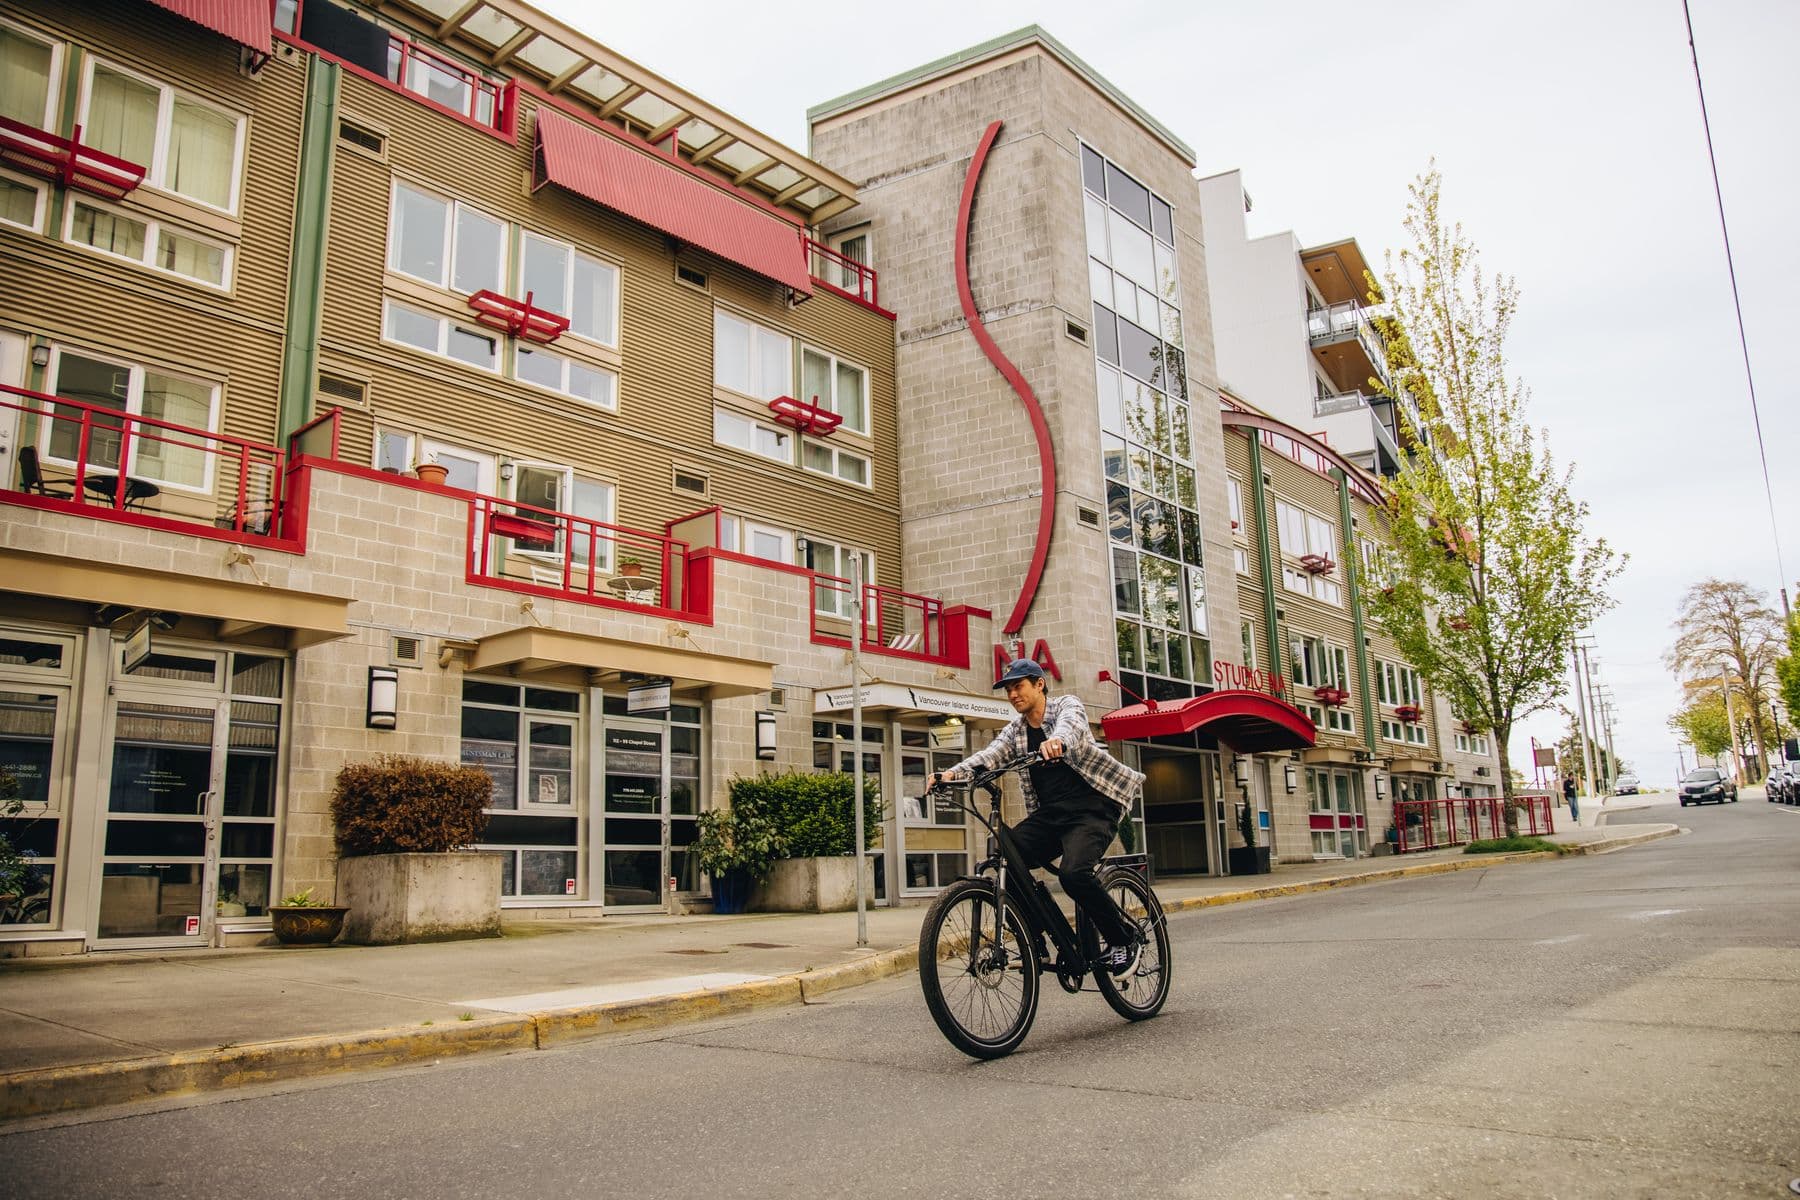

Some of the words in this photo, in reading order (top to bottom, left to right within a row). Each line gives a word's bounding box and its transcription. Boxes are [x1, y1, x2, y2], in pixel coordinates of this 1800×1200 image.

[993, 638, 1063, 682] NA
[1214, 661, 1263, 690] STUDIO
[1267, 672, 1287, 695] NA
[918, 695, 951, 707] Vancouver
[951, 700, 970, 710] Island
[970, 703, 999, 715] Appraisals
[999, 707, 1010, 716] Ltd
